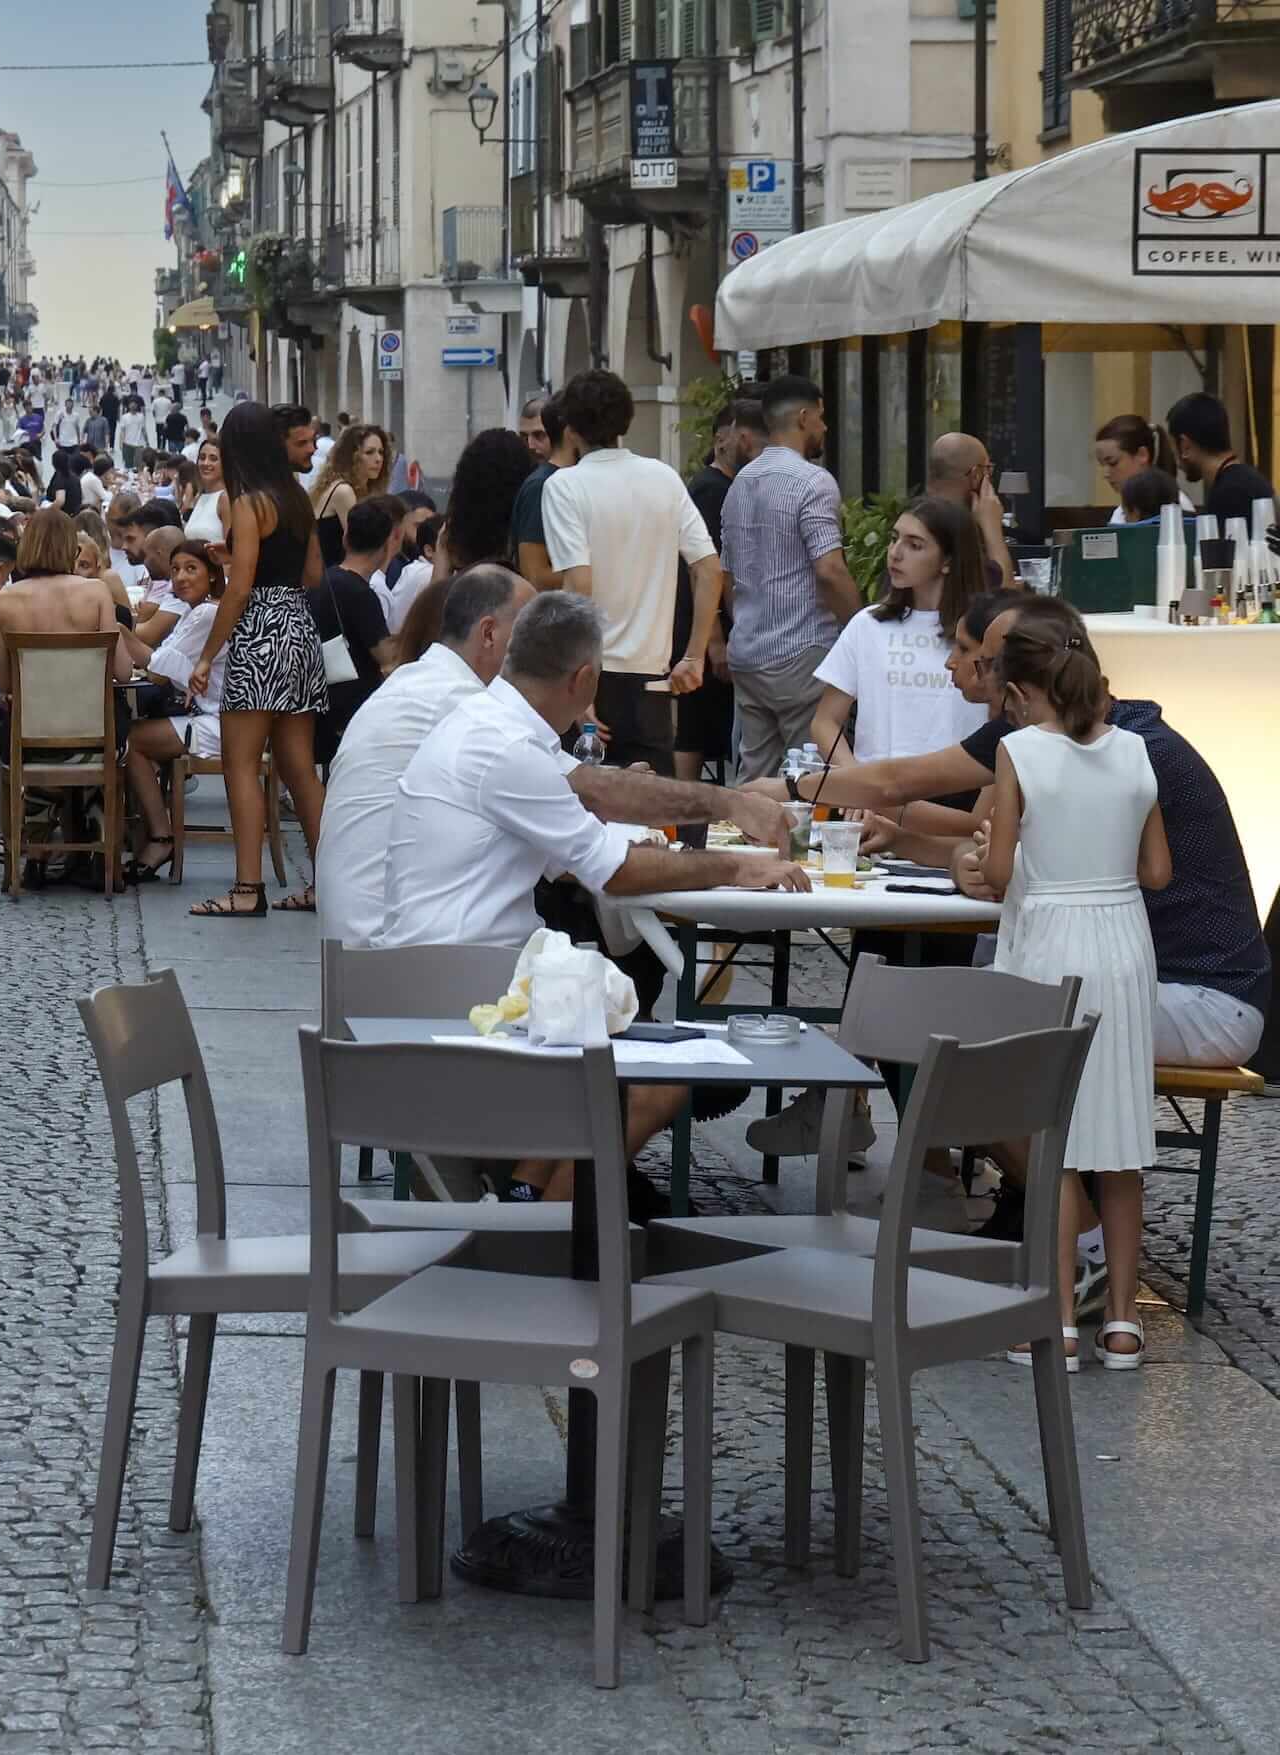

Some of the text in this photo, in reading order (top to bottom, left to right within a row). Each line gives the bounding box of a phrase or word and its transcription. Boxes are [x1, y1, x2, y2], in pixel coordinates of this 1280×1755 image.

[636, 67, 666, 118] T
[632, 162, 676, 177] LOTTO
[752, 165, 770, 190] P
[1147, 250, 1236, 264] COFFEE,
[888, 633, 945, 649] I LOV
[887, 651, 916, 666] TO
